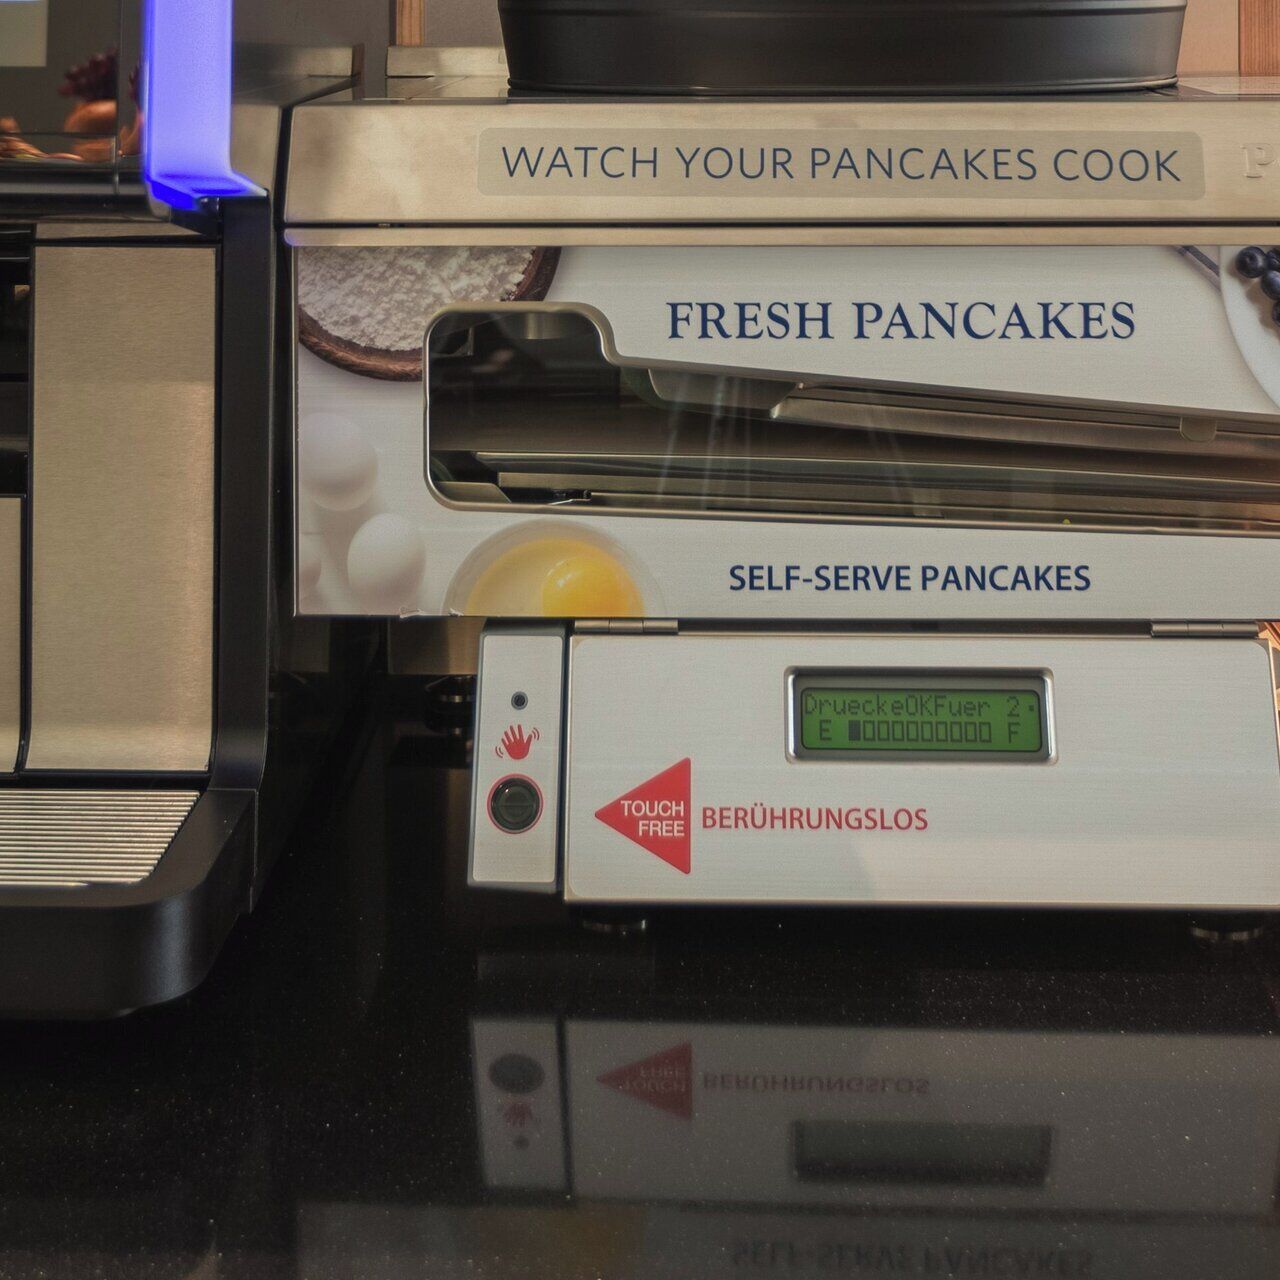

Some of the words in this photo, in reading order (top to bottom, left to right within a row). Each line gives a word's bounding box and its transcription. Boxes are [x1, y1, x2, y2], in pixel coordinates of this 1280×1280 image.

[502, 146, 658, 179] WATCH
[675, 146, 794, 180] YOUR
[811, 147, 1038, 182] PANCAKES
[1054, 148, 1182, 183] COOK
[666, 301, 835, 341] FRESH
[852, 300, 1137, 341] PANCAKES
[729, 565, 912, 591] SELF-SERVE
[921, 565, 1091, 591] PANCAKES
[1007, 696, 1020, 717] 2
[820, 719, 832, 741] E
[1008, 722, 1020, 743] F
[621, 800, 684, 817] TOUCH
[702, 802, 928, 831] BERÜHRUNGSLOS
[639, 821, 685, 837] FREE
